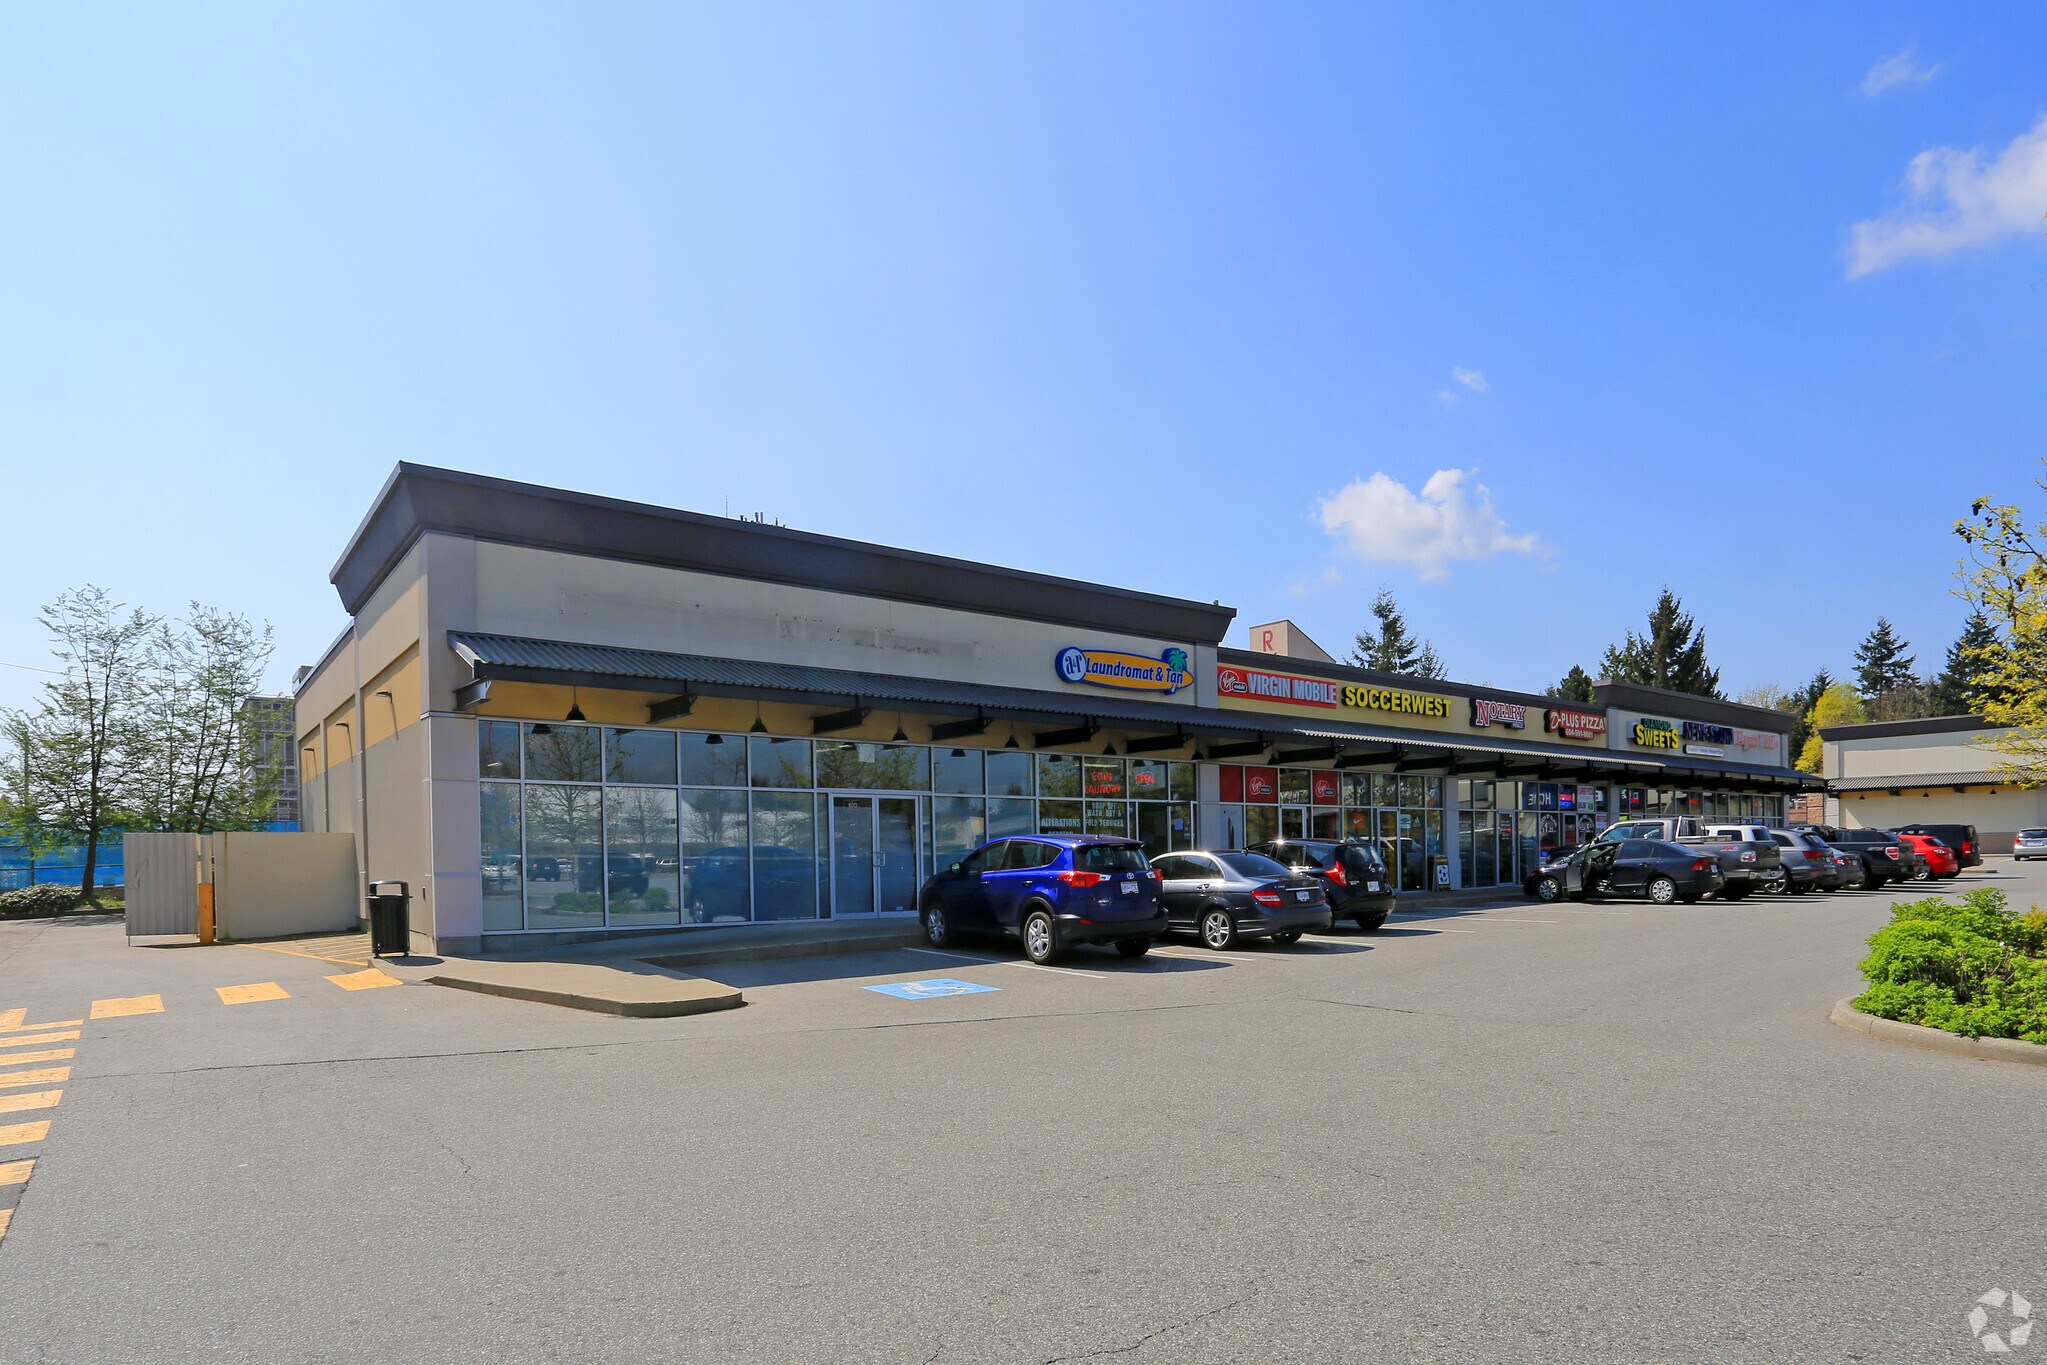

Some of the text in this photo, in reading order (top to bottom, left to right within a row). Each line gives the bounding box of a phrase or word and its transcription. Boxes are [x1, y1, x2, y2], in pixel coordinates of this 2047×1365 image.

[1262, 630, 1274, 652] R
[1085, 658, 1183, 684] Laundromat & Tan
[1247, 673, 1337, 704] VIRGIN MOBILE
[1345, 685, 1453, 717] SOCCERWEST
[1476, 700, 1526, 726] NOTARY
[1550, 711, 1579, 729] D-PLUS
[1636, 724, 1679, 749] SWEETS
[1091, 772, 1112, 781] COIN
[1135, 773, 1155, 785] OPEN
[1041, 818, 1081, 827] ALTERATIONS
[1099, 818, 1125, 827] SERVICES
